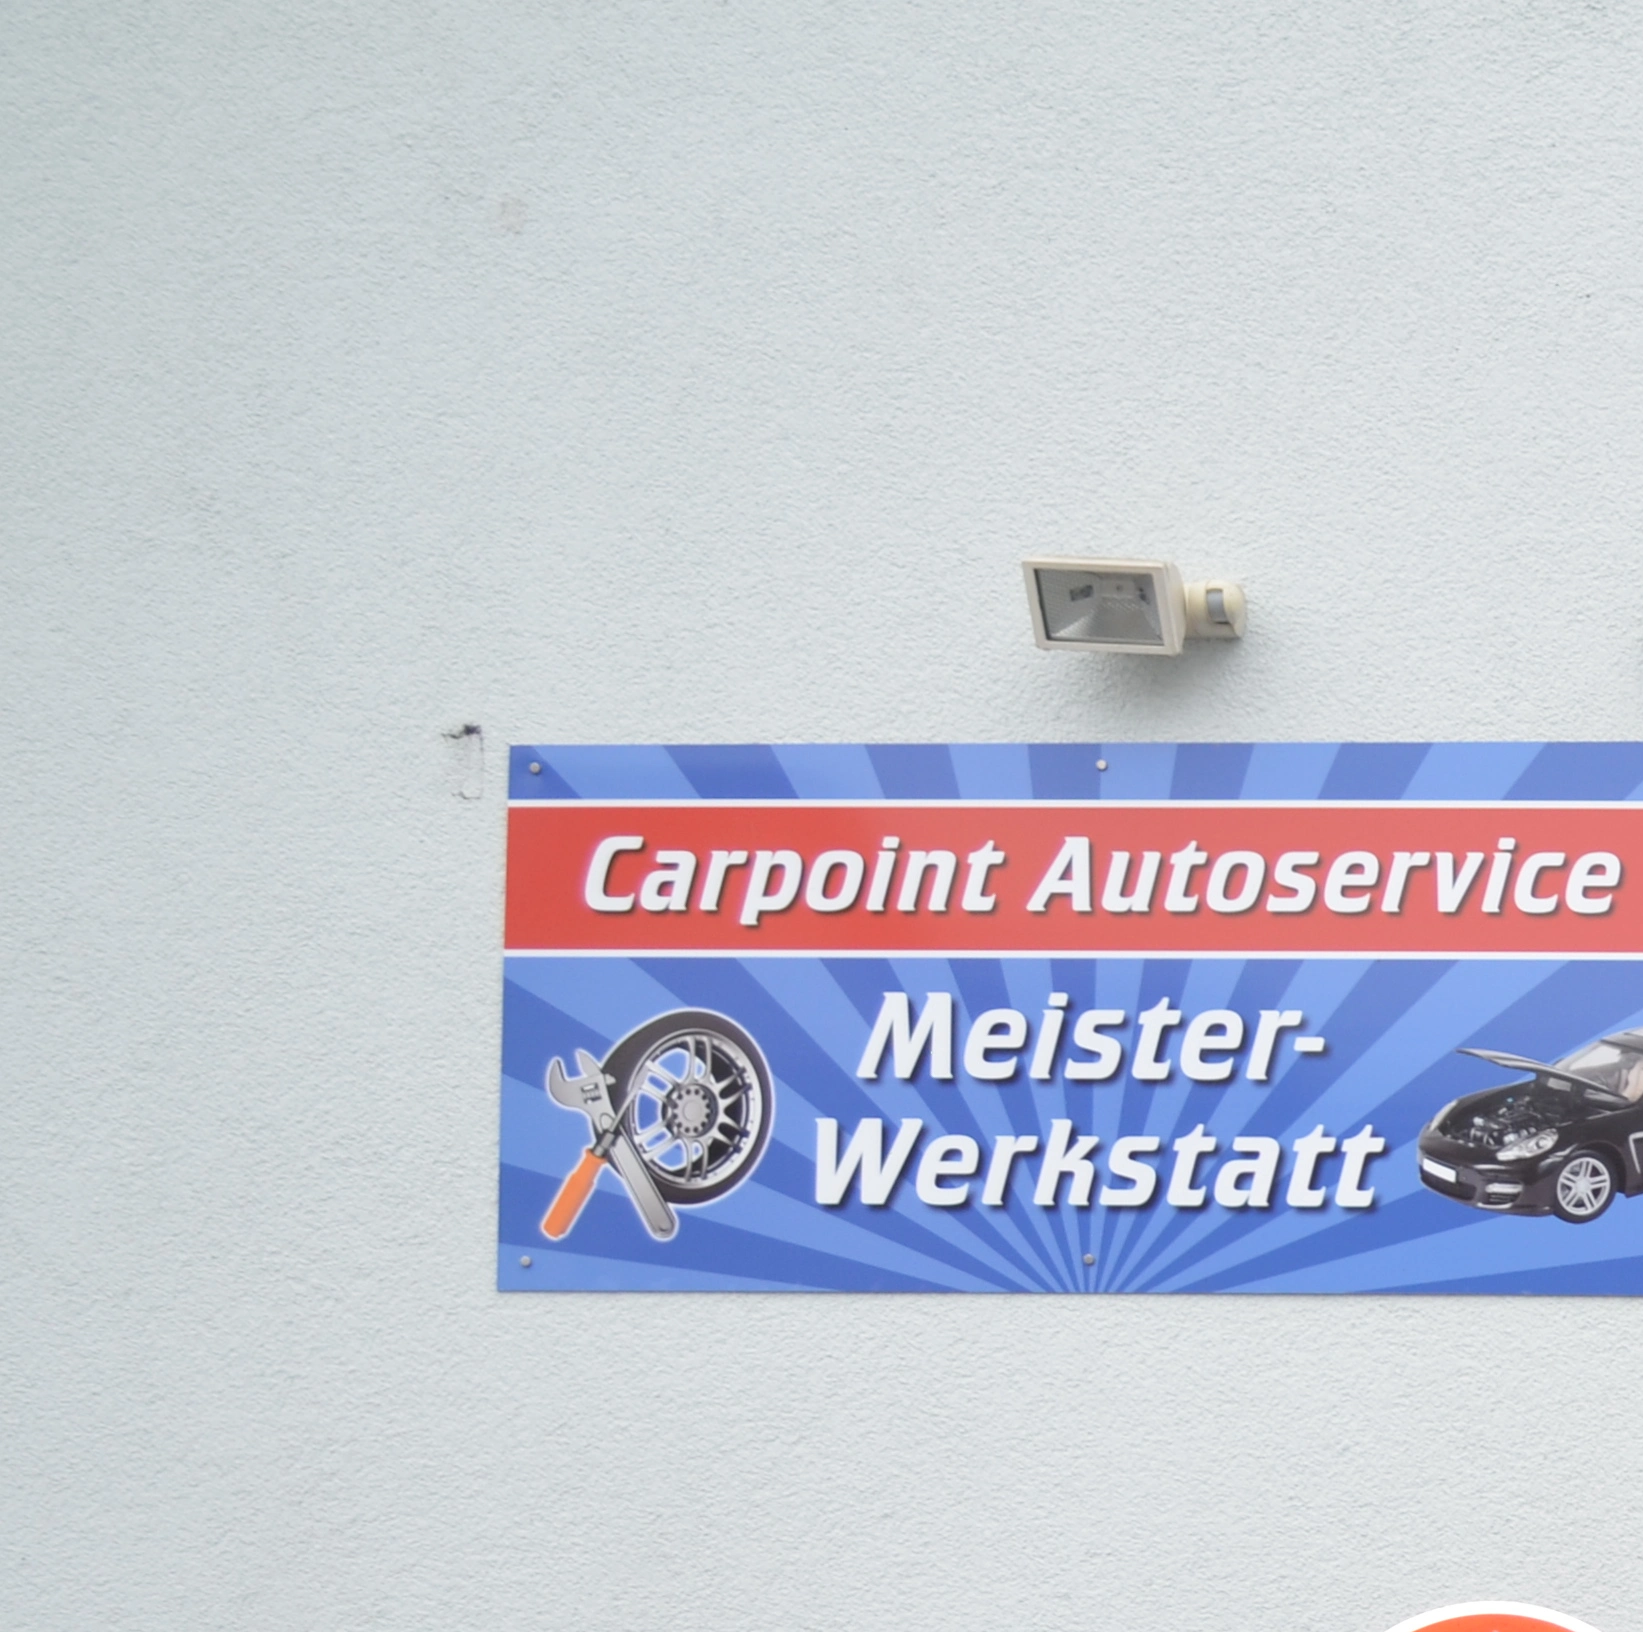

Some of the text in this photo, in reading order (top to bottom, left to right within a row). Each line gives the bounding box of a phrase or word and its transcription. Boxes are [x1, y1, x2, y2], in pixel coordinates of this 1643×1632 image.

[584, 835, 1622, 926] Carpoint Autoservice
[855, 991, 1326, 1081] Meister-
[813, 1117, 1386, 1209] Werkstatt
